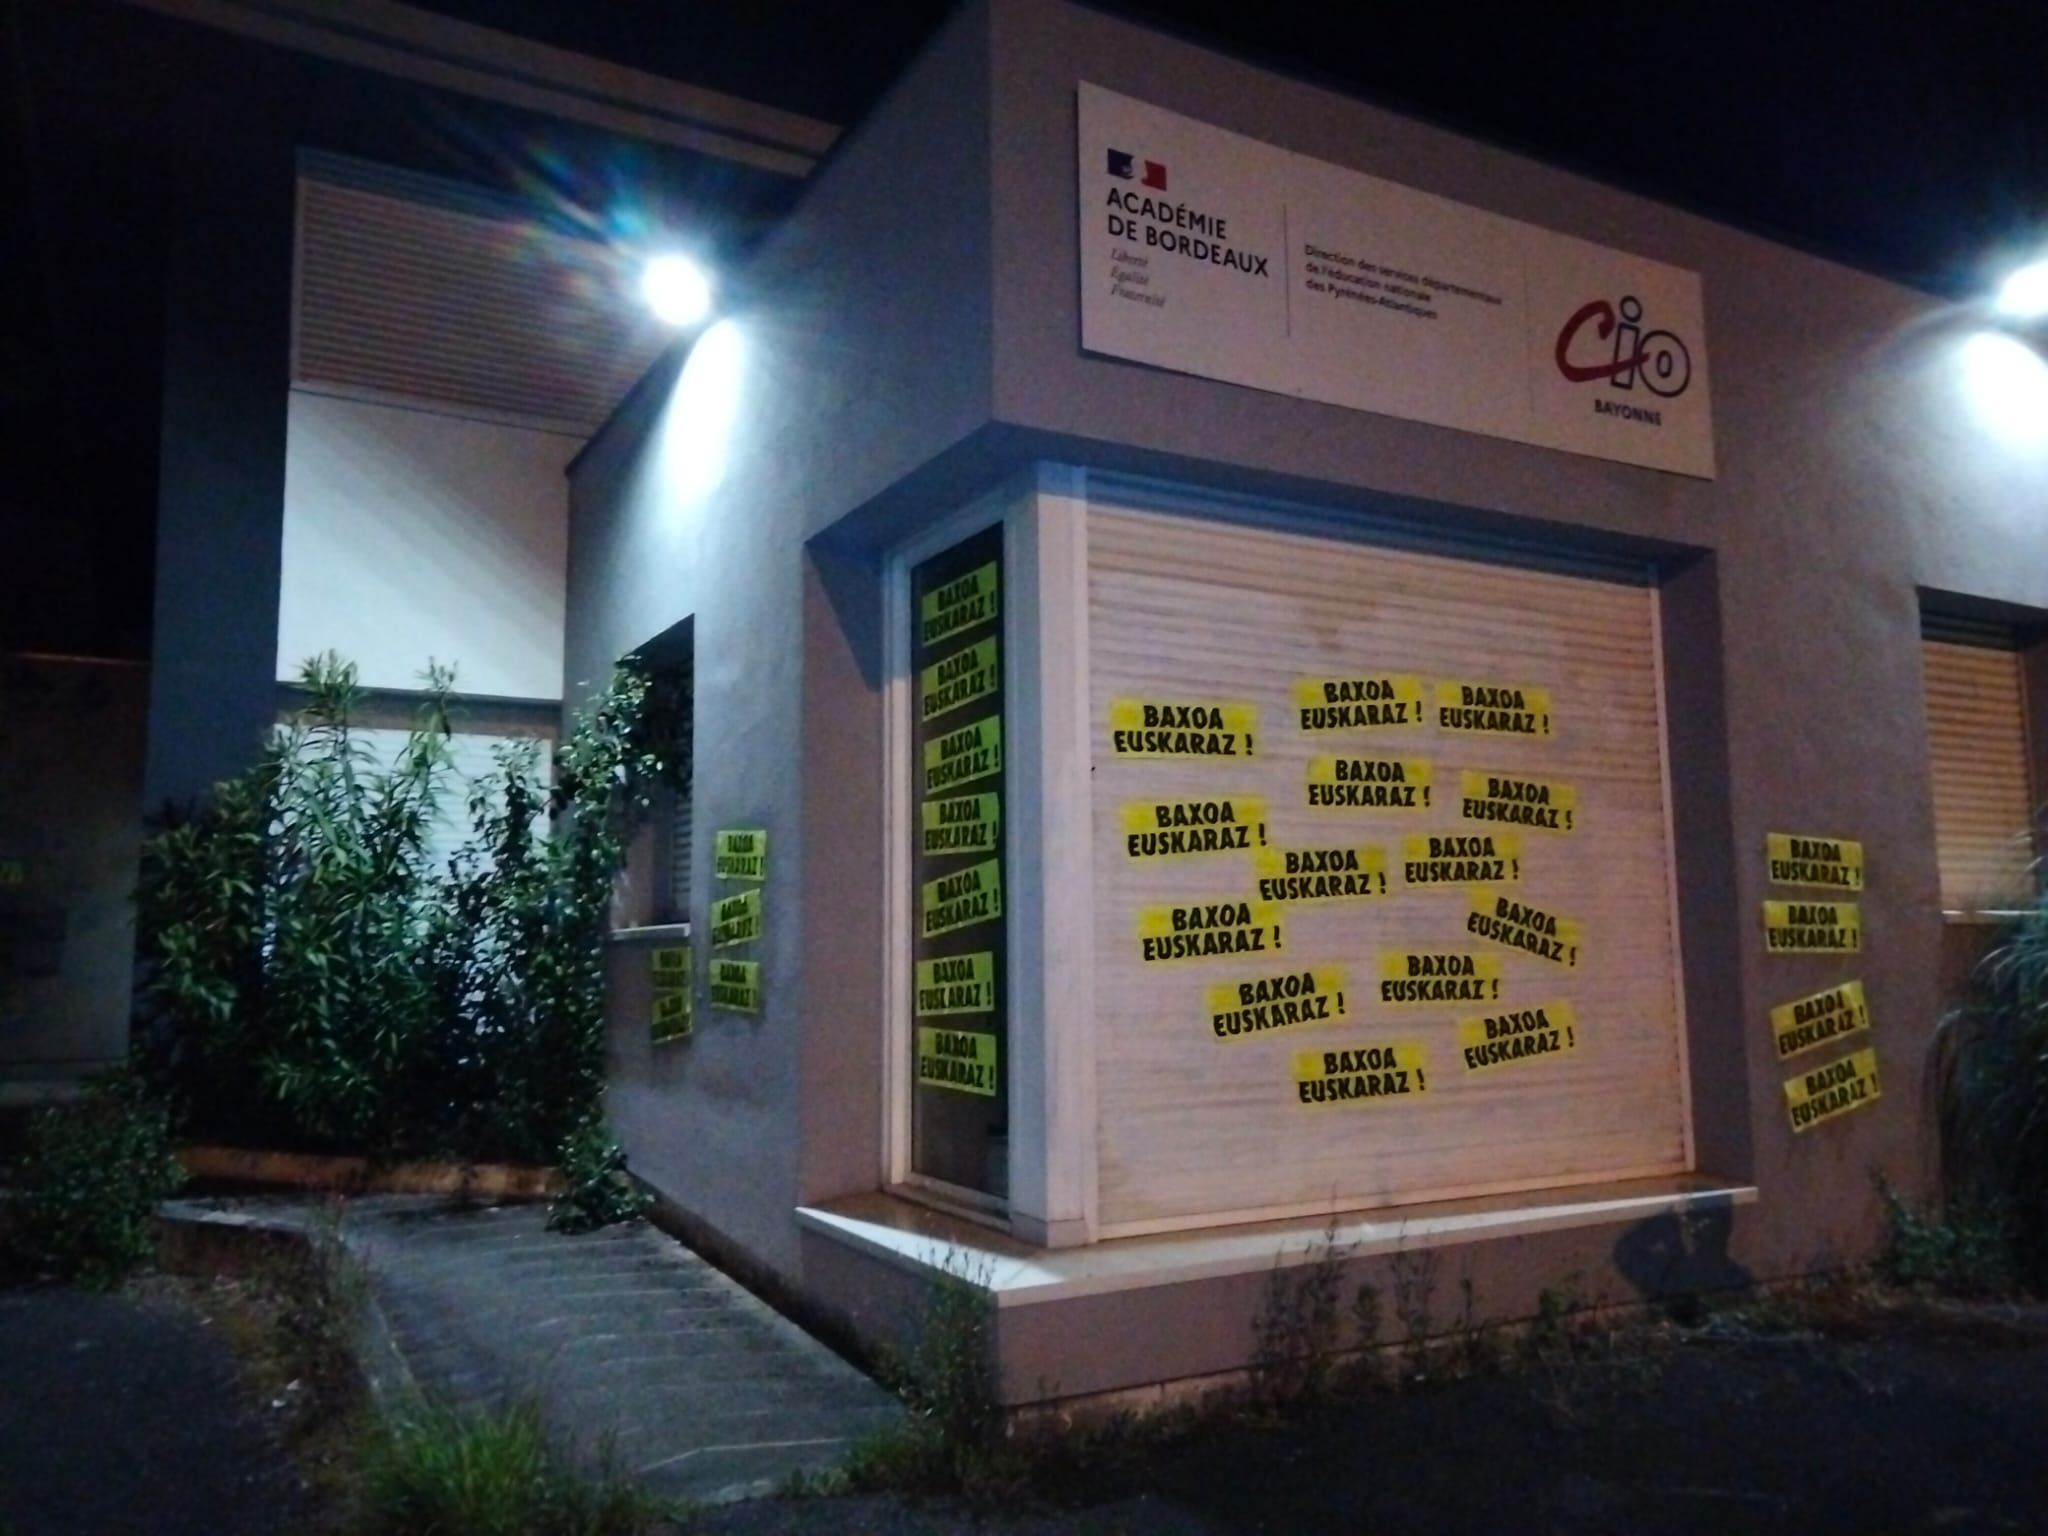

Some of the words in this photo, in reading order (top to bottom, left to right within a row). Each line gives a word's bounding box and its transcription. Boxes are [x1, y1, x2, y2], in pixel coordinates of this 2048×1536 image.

[1107, 188, 1226, 239] ACADÉMIE
[1108, 214, 1137, 241] DE
[1146, 226, 1268, 278] BORDEAUX
[1595, 400, 1662, 426] BAYONNE
[1324, 680, 1394, 703] BAXOA
[1462, 686, 1524, 709] BAXOA
[1144, 705, 1223, 729] BAXOA
[1300, 702, 1408, 730] EUSKARAZ
[1440, 707, 1535, 734] EUSKARAZ
[940, 726, 982, 760] BAXOA
[1114, 731, 1236, 755] EUSKARAZ
[1335, 760, 1404, 782] BAXOA
[1308, 784, 1415, 807] EUSKARAZ
[1488, 778, 1549, 805] BAXOA
[940, 798, 980, 825] BAXOA
[1156, 801, 1235, 828] BAXOA
[1463, 798, 1558, 828] EUSKARAZ
[1128, 826, 1250, 857] EUSKARAZ
[1429, 837, 1495, 858] BAXOA
[1790, 839, 1841, 862] BAXOA
[1286, 850, 1358, 874] BAXOA
[1405, 860, 1504, 883] EUSKARAZ
[1260, 873, 1370, 901] EUSKARAZ
[1172, 903, 1251, 931] BAXOA
[1496, 897, 1556, 936] BAXOA
[1788, 905, 1838, 925] BAXOA
[1143, 928, 1265, 961] EUSKARAZ
[1467, 911, 1564, 962] EUSKARAZ
[933, 958, 975, 984] BAXOA
[1407, 955, 1474, 976] BAXOA
[1239, 972, 1315, 1006] BAXOA
[1381, 979, 1485, 1001] EUSKARAZ
[1213, 995, 1329, 1037] EUSKARAZ
[1794, 990, 1844, 1024] BAXOA
[1484, 1009, 1549, 1039] BAXOA
[1324, 1047, 1397, 1074] BAXOA
[1464, 1030, 1560, 1069] EUSKARAZ
[1299, 1071, 1410, 1103] EUSKARAZ
[1806, 1059, 1856, 1096] BAXOA
